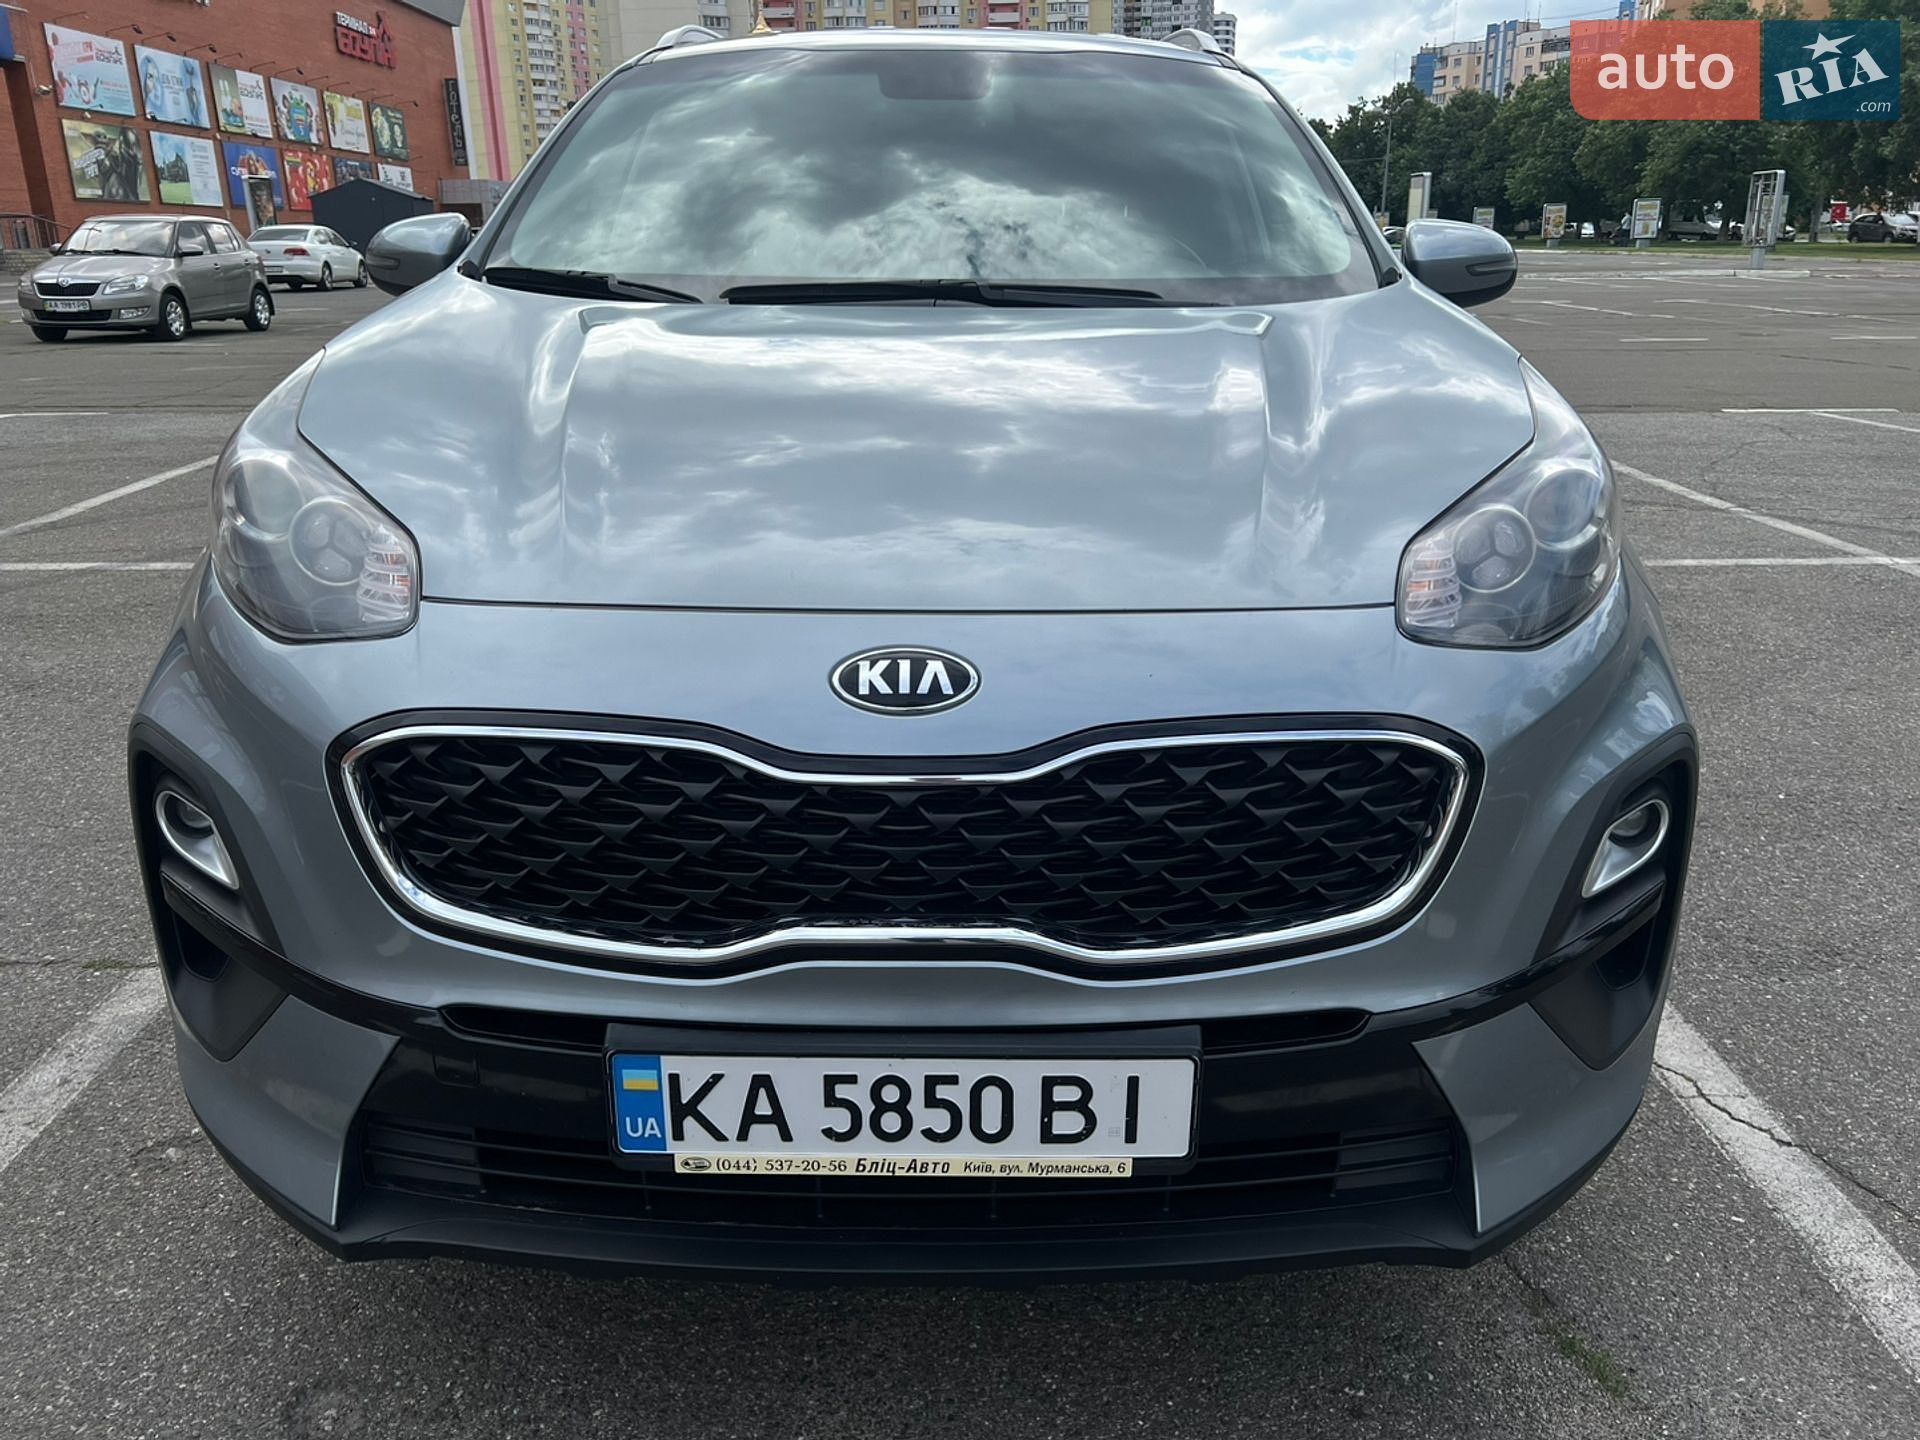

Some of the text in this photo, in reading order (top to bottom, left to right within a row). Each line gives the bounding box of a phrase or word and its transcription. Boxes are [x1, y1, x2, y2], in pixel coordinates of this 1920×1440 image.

[857, 659, 954, 695] KIA
[668, 1073, 1140, 1144] KA 5850 BI
[626, 1117, 662, 1138] UA
[716, 1157, 757, 1171] (044)
[764, 1158, 848, 1172] 537-20-56
[963, 1160, 996, 1175] Київ,
[1000, 1163, 1024, 1175] вул.
[1028, 1161, 1113, 1175] Мурманська,
[1117, 1161, 1127, 1174] 6
